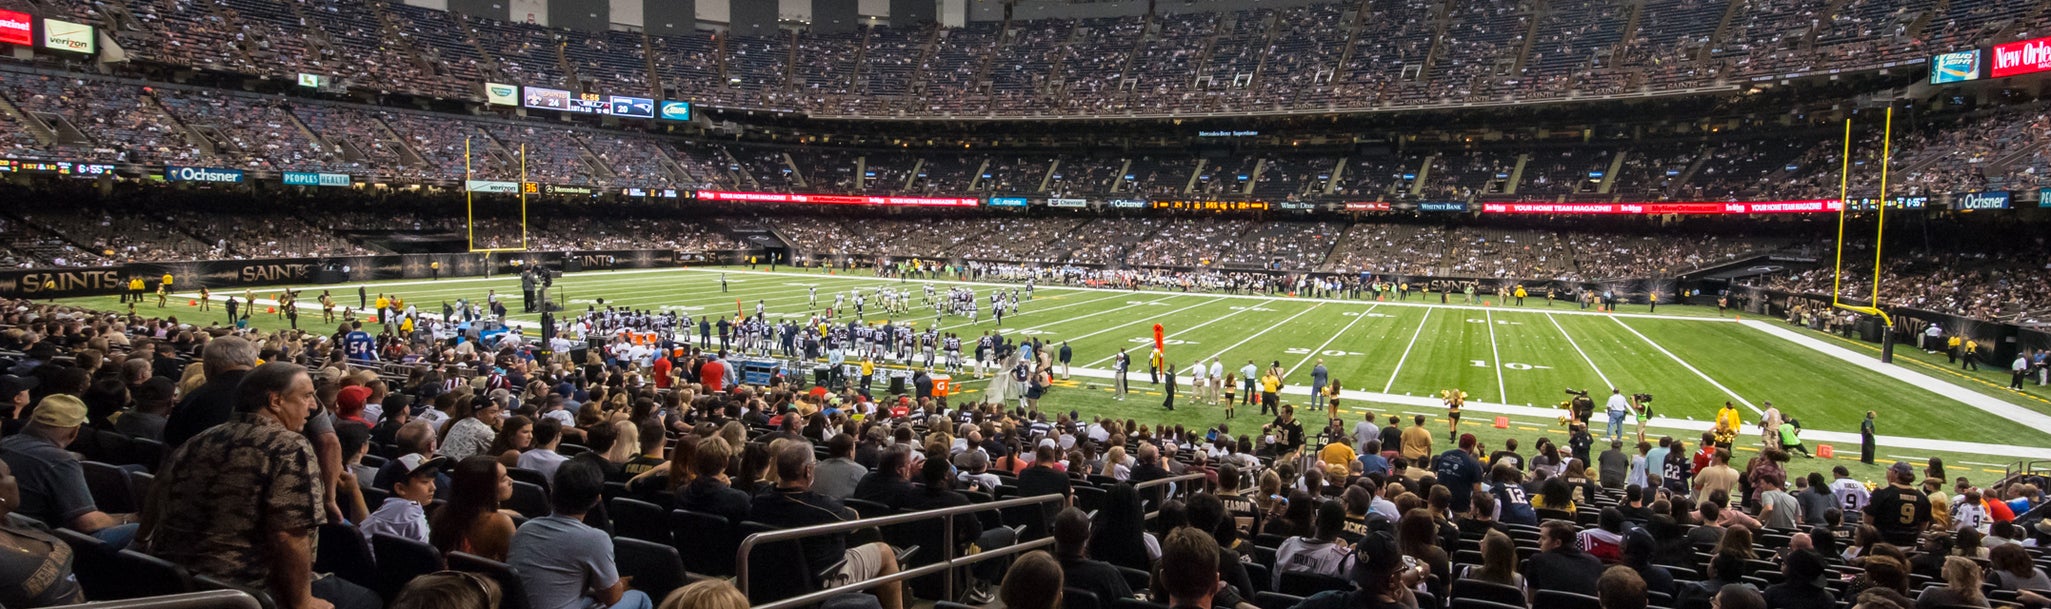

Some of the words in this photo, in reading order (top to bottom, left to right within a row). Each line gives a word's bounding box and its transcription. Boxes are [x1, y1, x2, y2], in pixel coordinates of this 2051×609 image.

[50, 37, 87, 48] verizon
[156, 54, 191, 65] SAINTS
[1994, 47, 2022, 69] New
[548, 98, 559, 106] 24
[580, 93, 599, 101] 6:55
[617, 105, 628, 113] 20
[78, 164, 103, 174] 6:55
[181, 167, 238, 182] Ochsner
[284, 173, 318, 184] PEOPLES
[320, 174, 349, 185] HEALTH
[526, 183, 537, 193] 36
[555, 185, 591, 194] Mercedes-Benz
[1115, 199, 1144, 209] Ochsner
[1906, 199, 1920, 207] 6:55
[1964, 193, 2004, 209] Ochsner
[1421, 203, 1446, 211] WHITNEY
[242, 264, 310, 282] SAINTS
[22, 270, 120, 294] SAINTS
[350, 341, 368, 354] 54
[936, 381, 945, 391] G
[1664, 463, 1680, 480] 22
[1505, 488, 1528, 505] 12
[1845, 494, 1857, 509] 9
[1901, 503, 1915, 524] 9
[1972, 515, 1980, 528] 9
